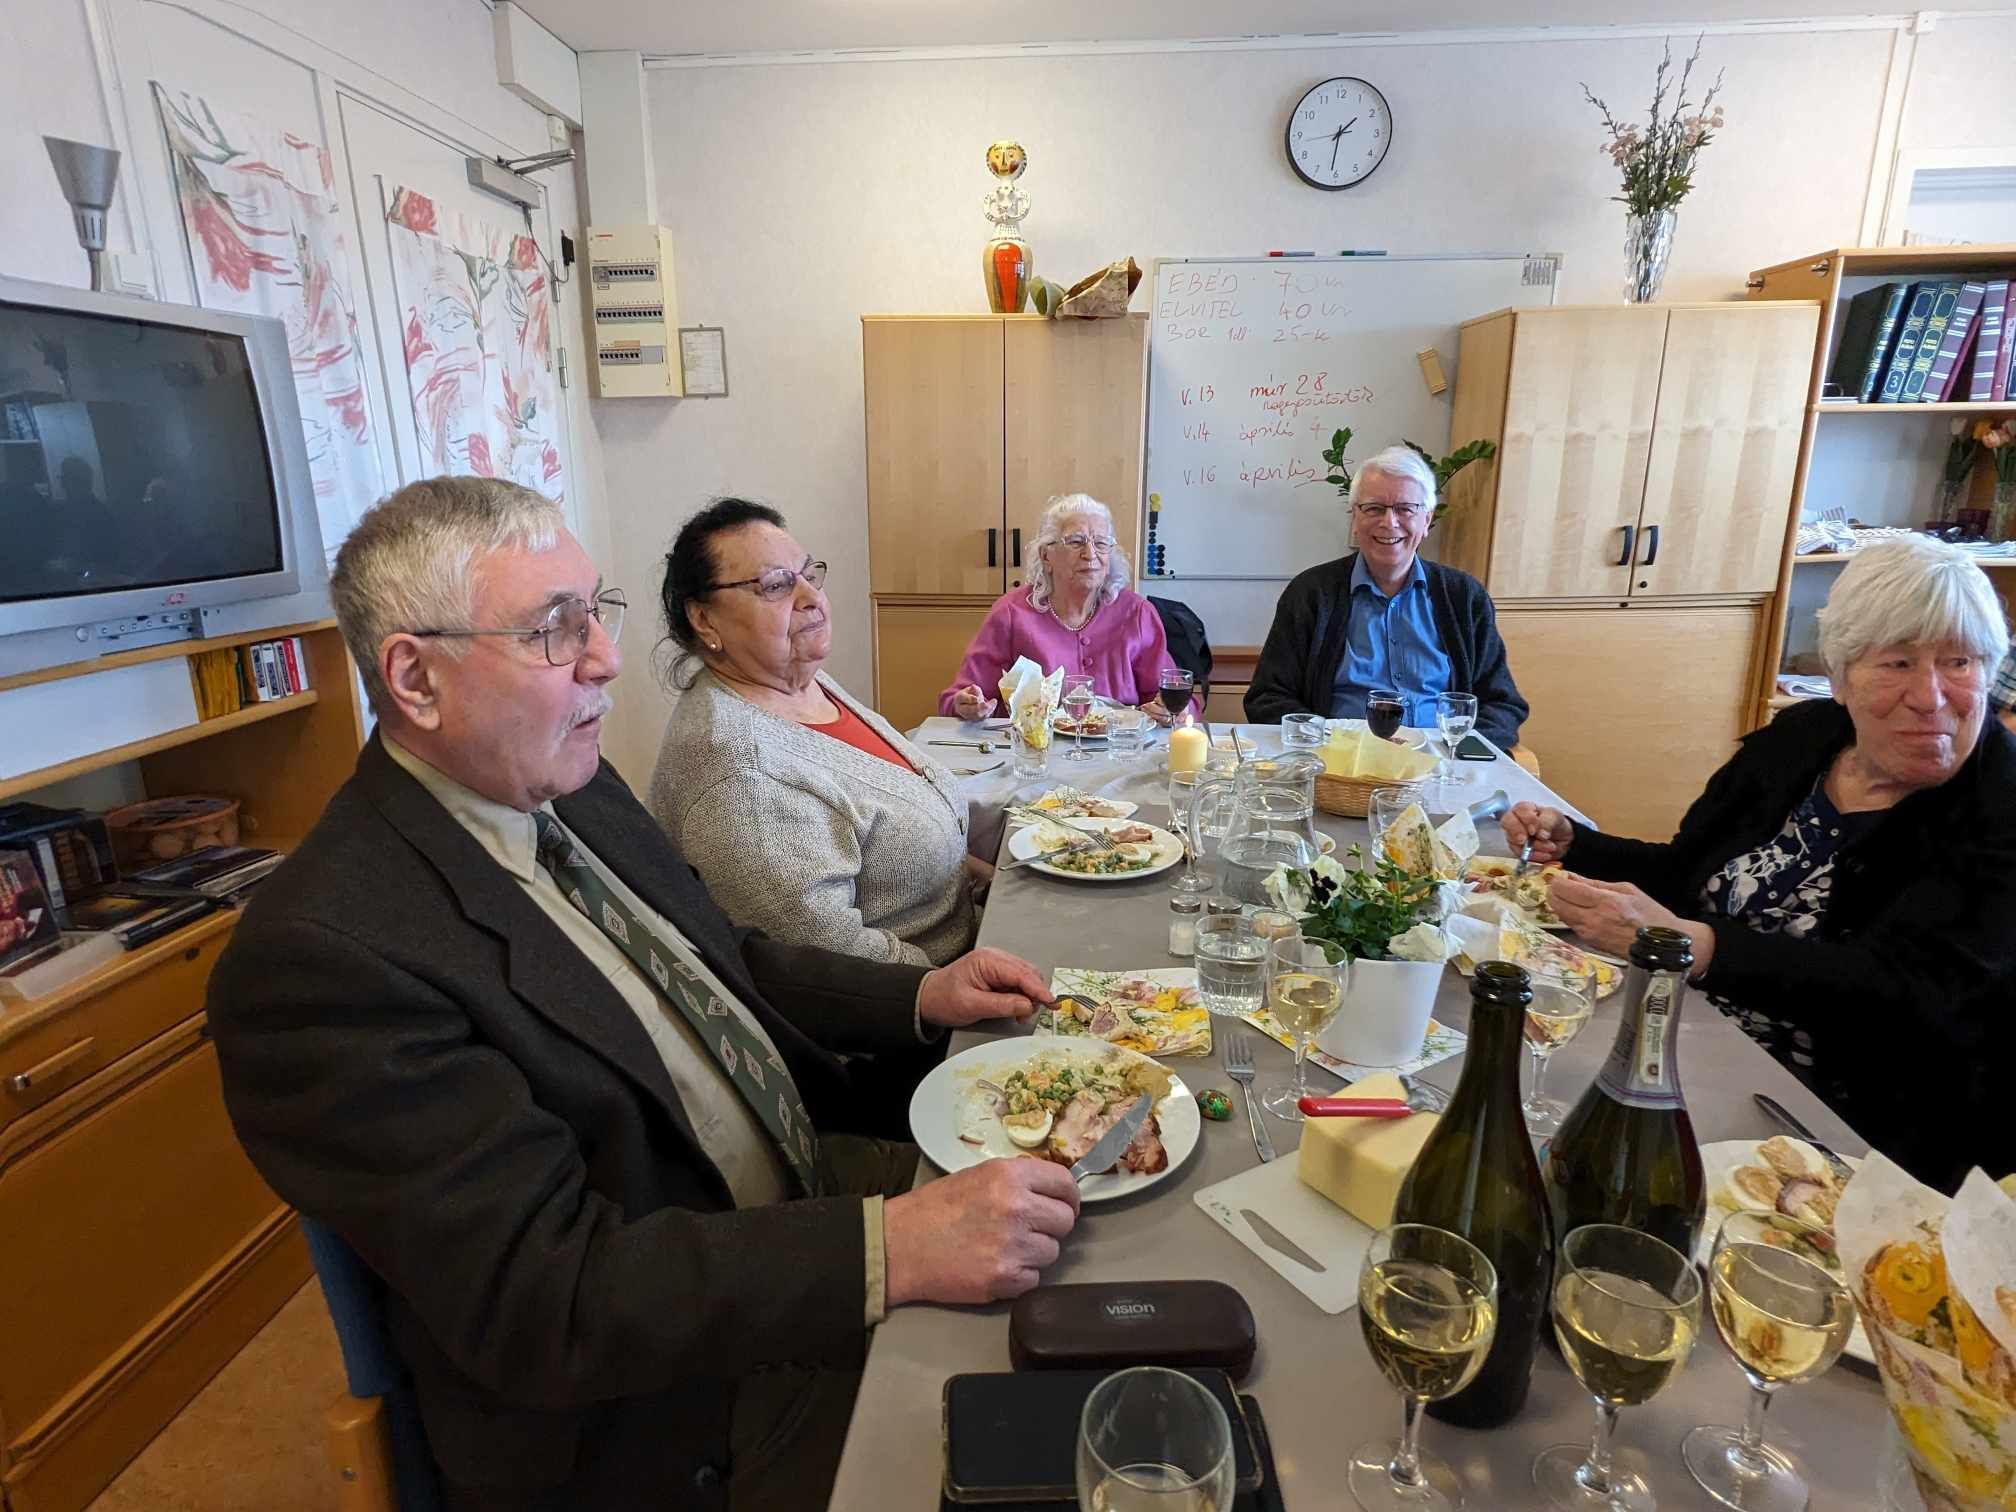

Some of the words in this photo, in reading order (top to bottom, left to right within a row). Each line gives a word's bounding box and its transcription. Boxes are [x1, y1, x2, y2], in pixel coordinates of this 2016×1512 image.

[1336, 89, 1348, 99] 12
[1358, 94, 1363, 103] 1
[1320, 95, 1329, 105] 11
[1305, 110, 1315, 120] 10
[1369, 109, 1376, 118] 2
[1297, 131, 1303, 140] 9
[1374, 129, 1380, 138] 3
[1301, 150, 1308, 160] 8
[1368, 149, 1374, 157] 4
[1314, 164, 1320, 174] 7
[1352, 164, 1359, 173] 5
[1333, 170, 1339, 178] 6
[1279, 299, 1313, 321] 40
[1296, 372, 1329, 395] 28
[1889, 375, 1899, 388] 3
